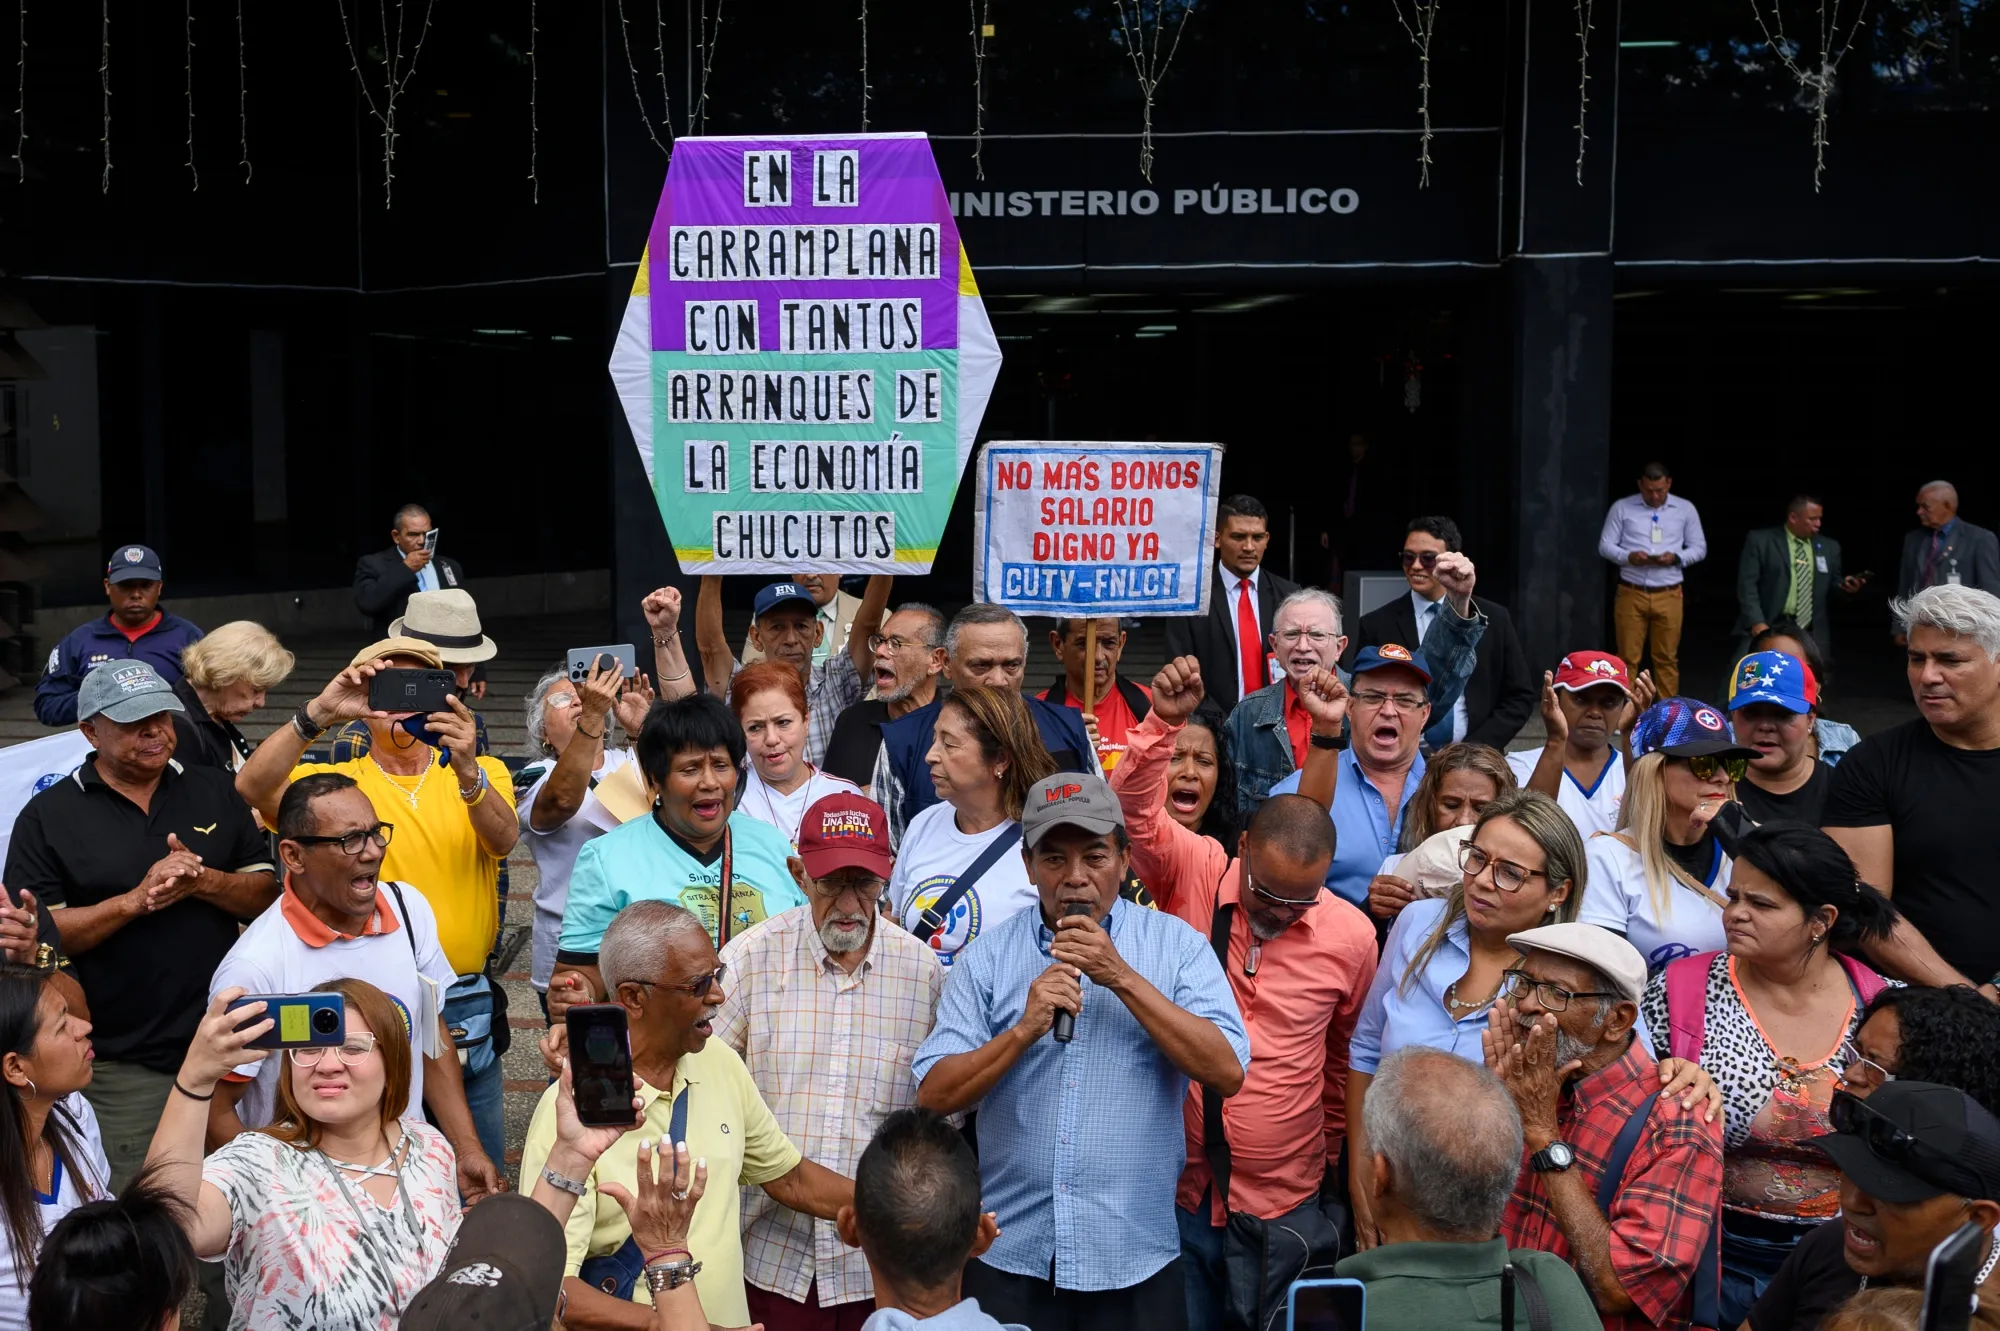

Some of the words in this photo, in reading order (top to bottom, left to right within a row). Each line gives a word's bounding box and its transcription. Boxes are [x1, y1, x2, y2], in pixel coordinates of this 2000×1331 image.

[748, 154, 788, 203] EN
[818, 155, 855, 203] LA
[950, 190, 1160, 217] INISTERIO
[1174, 182, 1360, 215] PÚBLICO
[674, 227, 936, 278] CARRAMPLANA
[689, 303, 755, 352] CON
[784, 302, 918, 352] TANTOS
[671, 373, 872, 422] ARRANQUES
[900, 371, 937, 419] DE
[689, 444, 727, 490] LA
[753, 433, 919, 491] ECONOMÍA
[998, 461, 1033, 490] NO
[1042, 455, 1100, 491] MÁS
[1111, 461, 1201, 489] BONOS
[1040, 496, 1154, 526] SALARIO
[716, 514, 891, 560] CHUCUTOS
[1032, 531, 1116, 562] DIGNO
[1127, 532, 1160, 560] YA
[1005, 567, 1177, 600] CUTV-FNLCT
[1045, 784, 1082, 802] VP
[821, 823, 876, 842] LUCHA
[822, 816, 844, 827] UNA
[845, 815, 870, 828] SOLA
